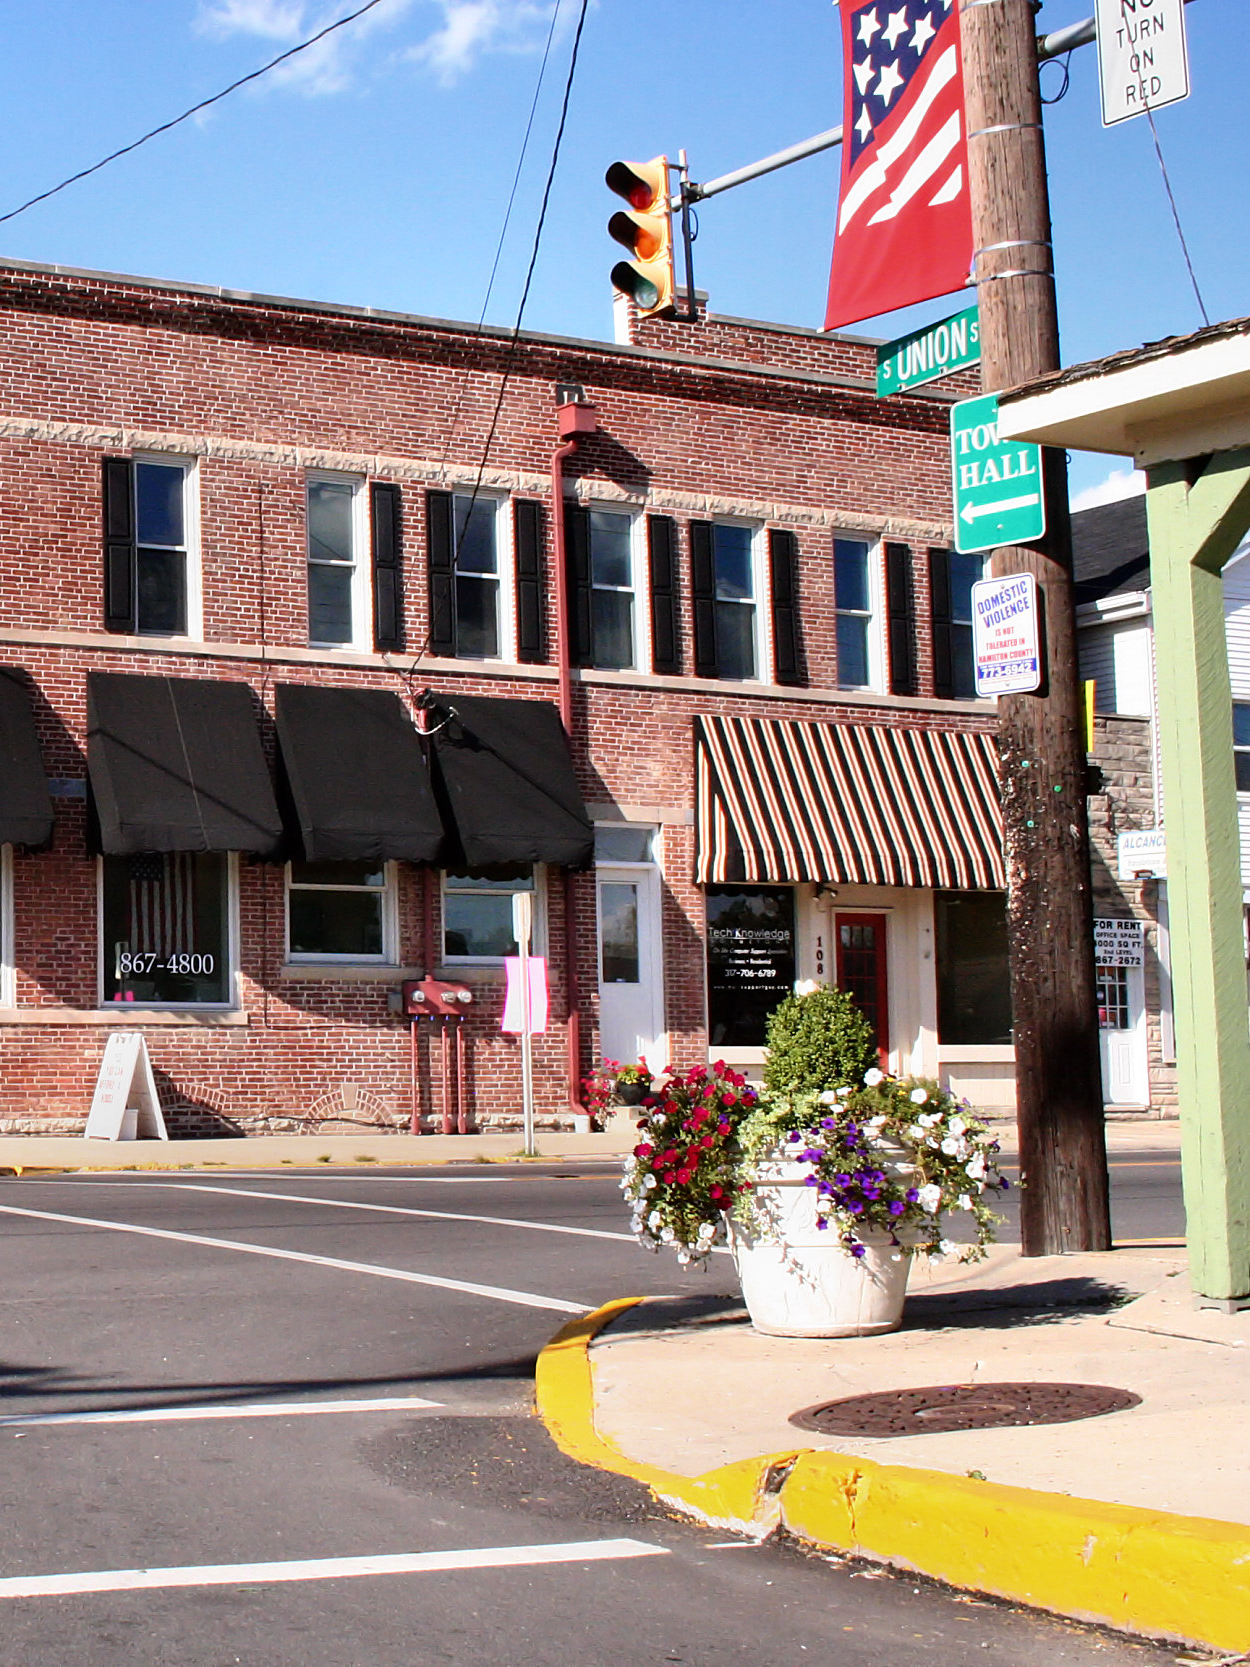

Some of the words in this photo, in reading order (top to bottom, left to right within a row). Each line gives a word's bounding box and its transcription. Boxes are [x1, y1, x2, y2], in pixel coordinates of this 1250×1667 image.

[1116, 12, 1164, 48] TURN
[1130, 47, 1154, 73] ON
[1126, 76, 1161, 105] RED
[883, 360, 892, 379] S
[897, 318, 967, 380] UNION
[955, 421, 1010, 455] TO
[959, 450, 1036, 490] HALL
[977, 581, 1028, 615] DOMESTIC
[983, 596, 1030, 628] VIOLENCE
[995, 628, 1001, 637] IS
[1002, 626, 1014, 635] NOT
[978, 651, 1008, 663] HAMILTON
[1009, 648, 1033, 659] COUNTY
[986, 638, 1017, 650] TOLERATED
[981, 662, 1032, 679] 773-6942
[708, 927, 733, 938] Tech
[735, 927, 790, 940] Knowledge
[1093, 920, 1112, 929] FOR
[1117, 921, 1141, 930] RENT
[120, 952, 215, 975] 867-4800
[1095, 955, 1141, 965] 867-2672
[725, 969, 776, 978] 317-706-6789
